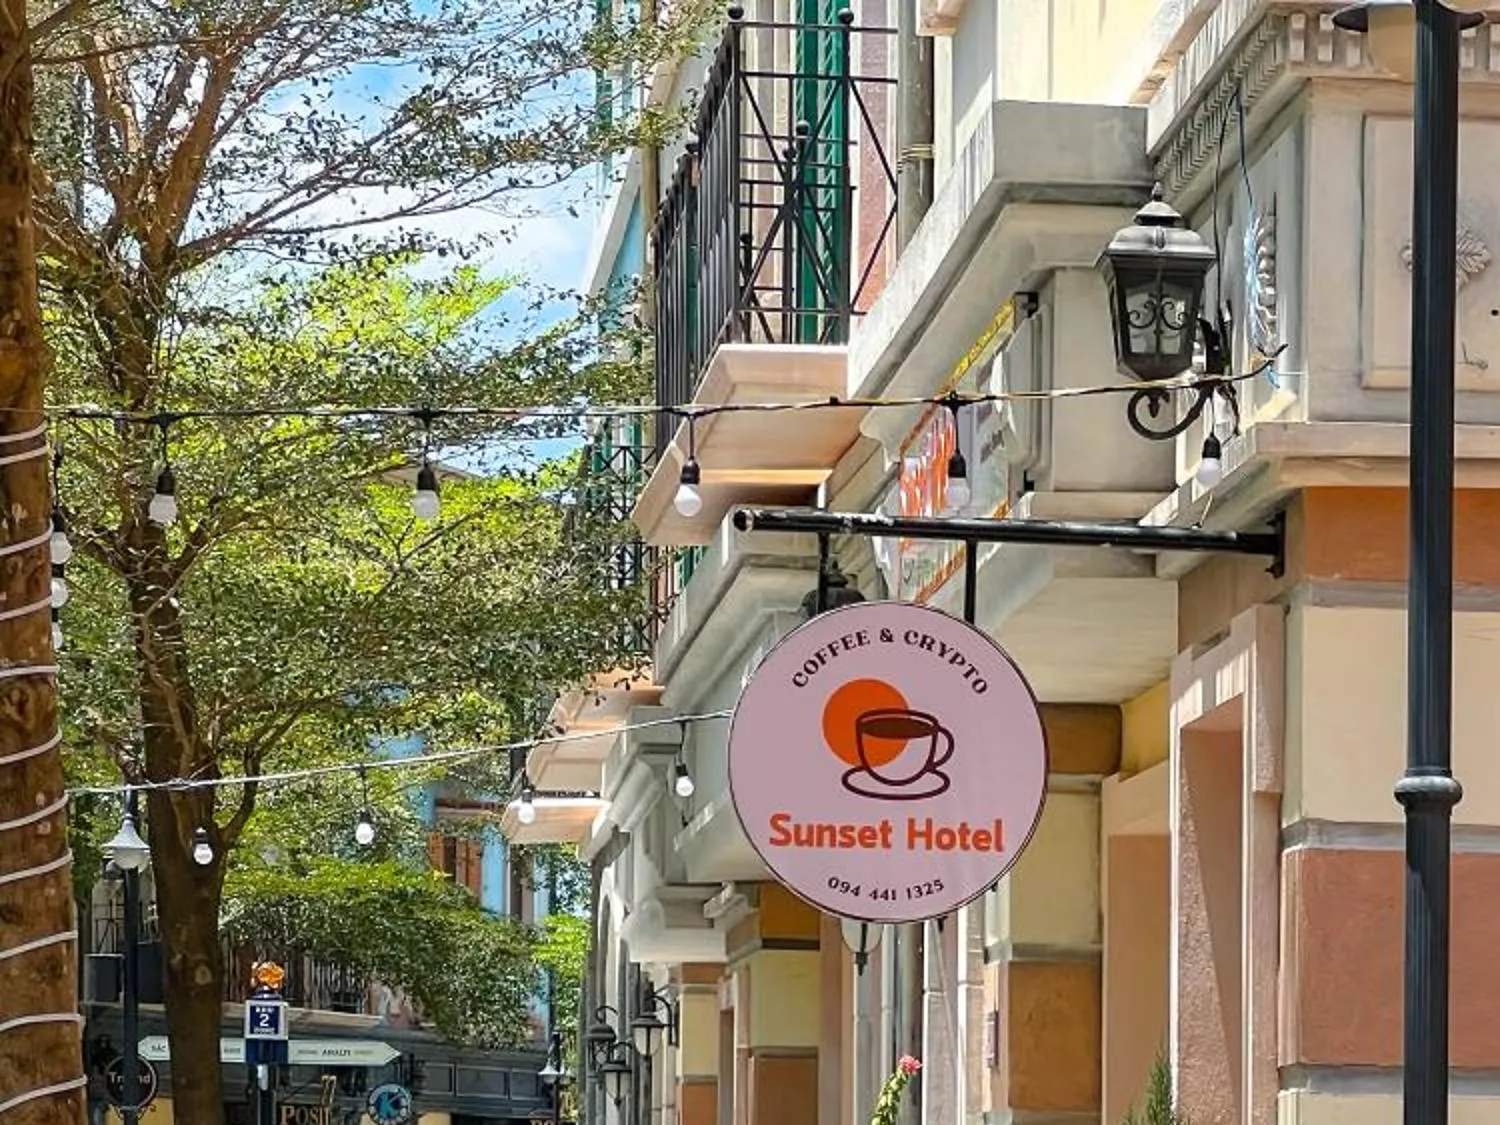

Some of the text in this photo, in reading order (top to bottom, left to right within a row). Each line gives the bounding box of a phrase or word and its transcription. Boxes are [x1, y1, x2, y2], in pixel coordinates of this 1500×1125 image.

[791, 627, 989, 694] COFFEE & CRYPTO
[769, 812, 1004, 852] Sunset Hotel
[827, 876, 944, 901] 094 441 1325
[259, 1013, 270, 1026] 2
